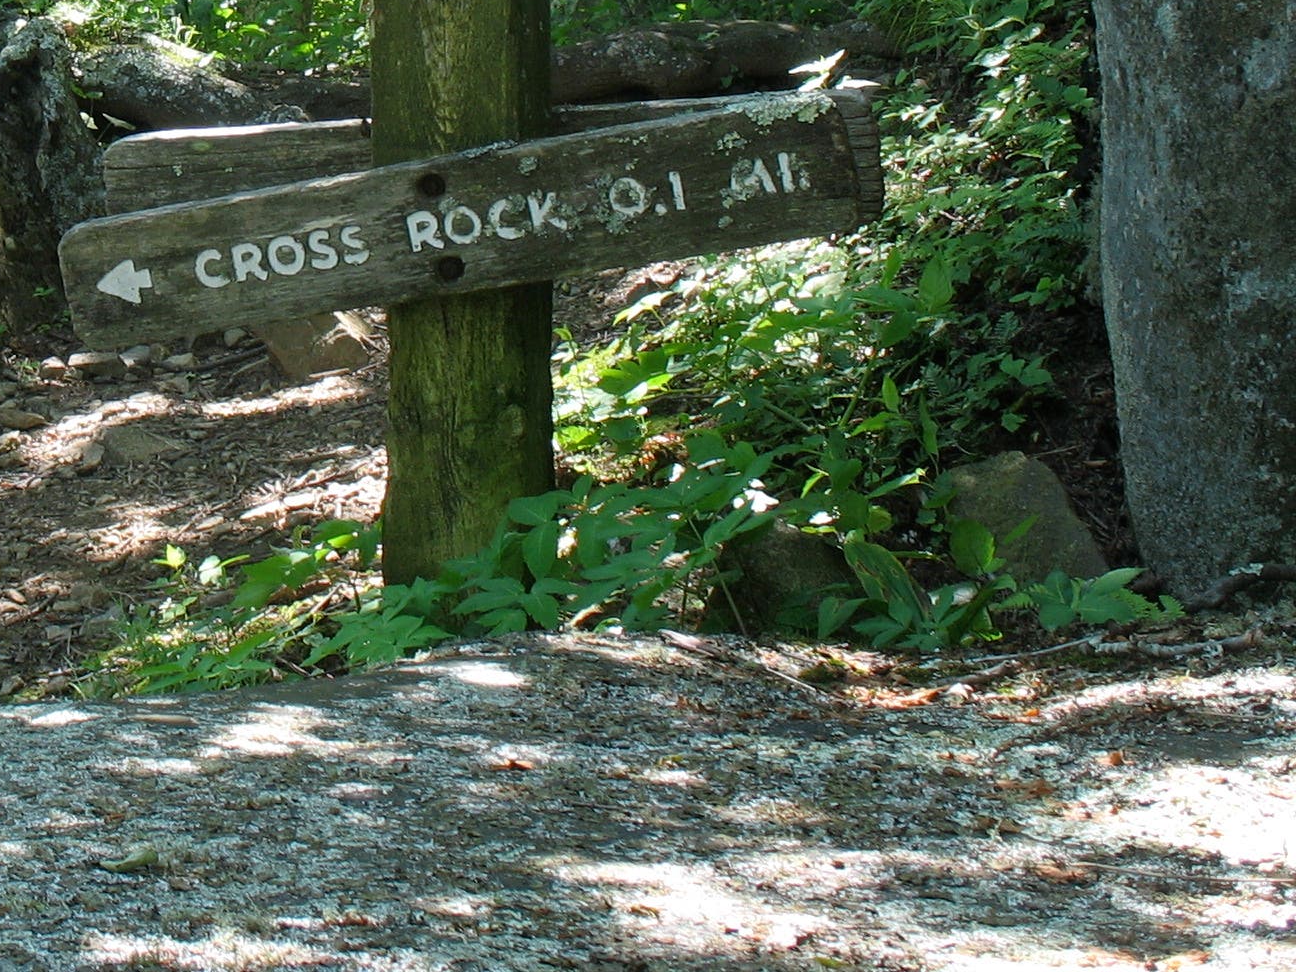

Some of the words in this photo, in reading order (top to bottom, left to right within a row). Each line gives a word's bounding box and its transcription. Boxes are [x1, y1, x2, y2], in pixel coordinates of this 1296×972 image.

[194, 226, 371, 288] CROSS
[406, 191, 568, 253] ROCK
[608, 171, 686, 214] 0.1
